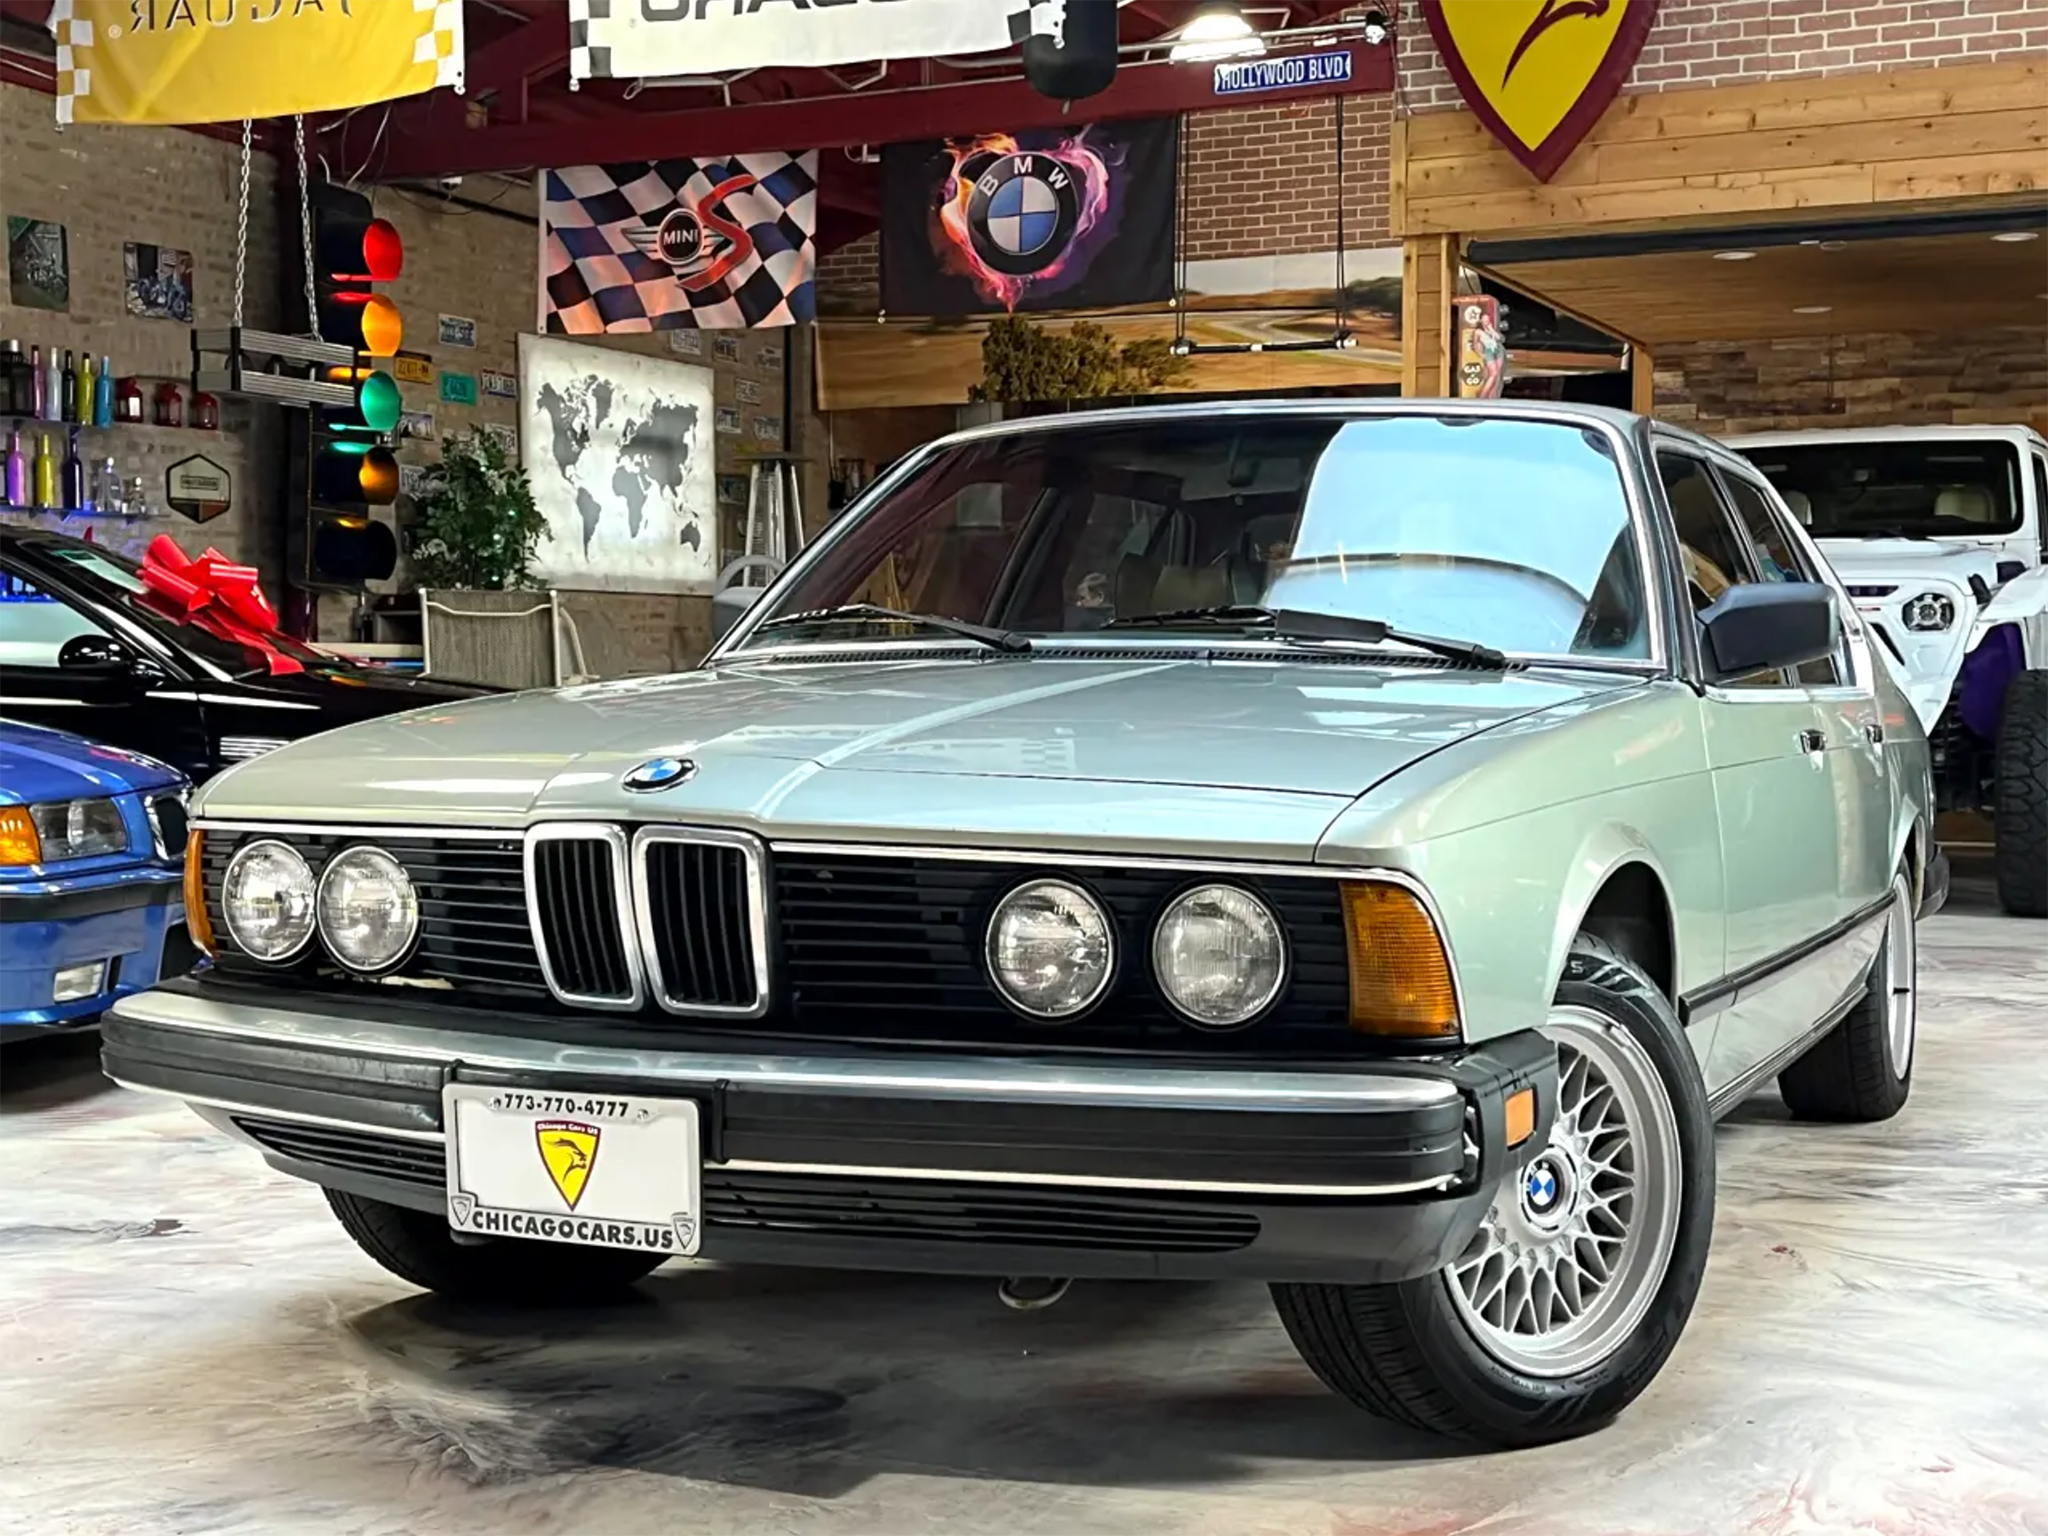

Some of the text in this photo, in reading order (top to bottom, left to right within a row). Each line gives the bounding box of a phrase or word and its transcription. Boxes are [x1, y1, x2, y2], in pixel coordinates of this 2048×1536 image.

[1221, 56, 1343, 90] HOLLYWOOD BLVD
[979, 156, 1069, 197] BMW
[663, 229, 698, 246] MINI
[504, 1093, 629, 1117] 773-770-4777
[537, 1123, 566, 1132] Chicago
[568, 1123, 586, 1133] Cars
[472, 1211, 674, 1249] CHICAGOCARS.US
